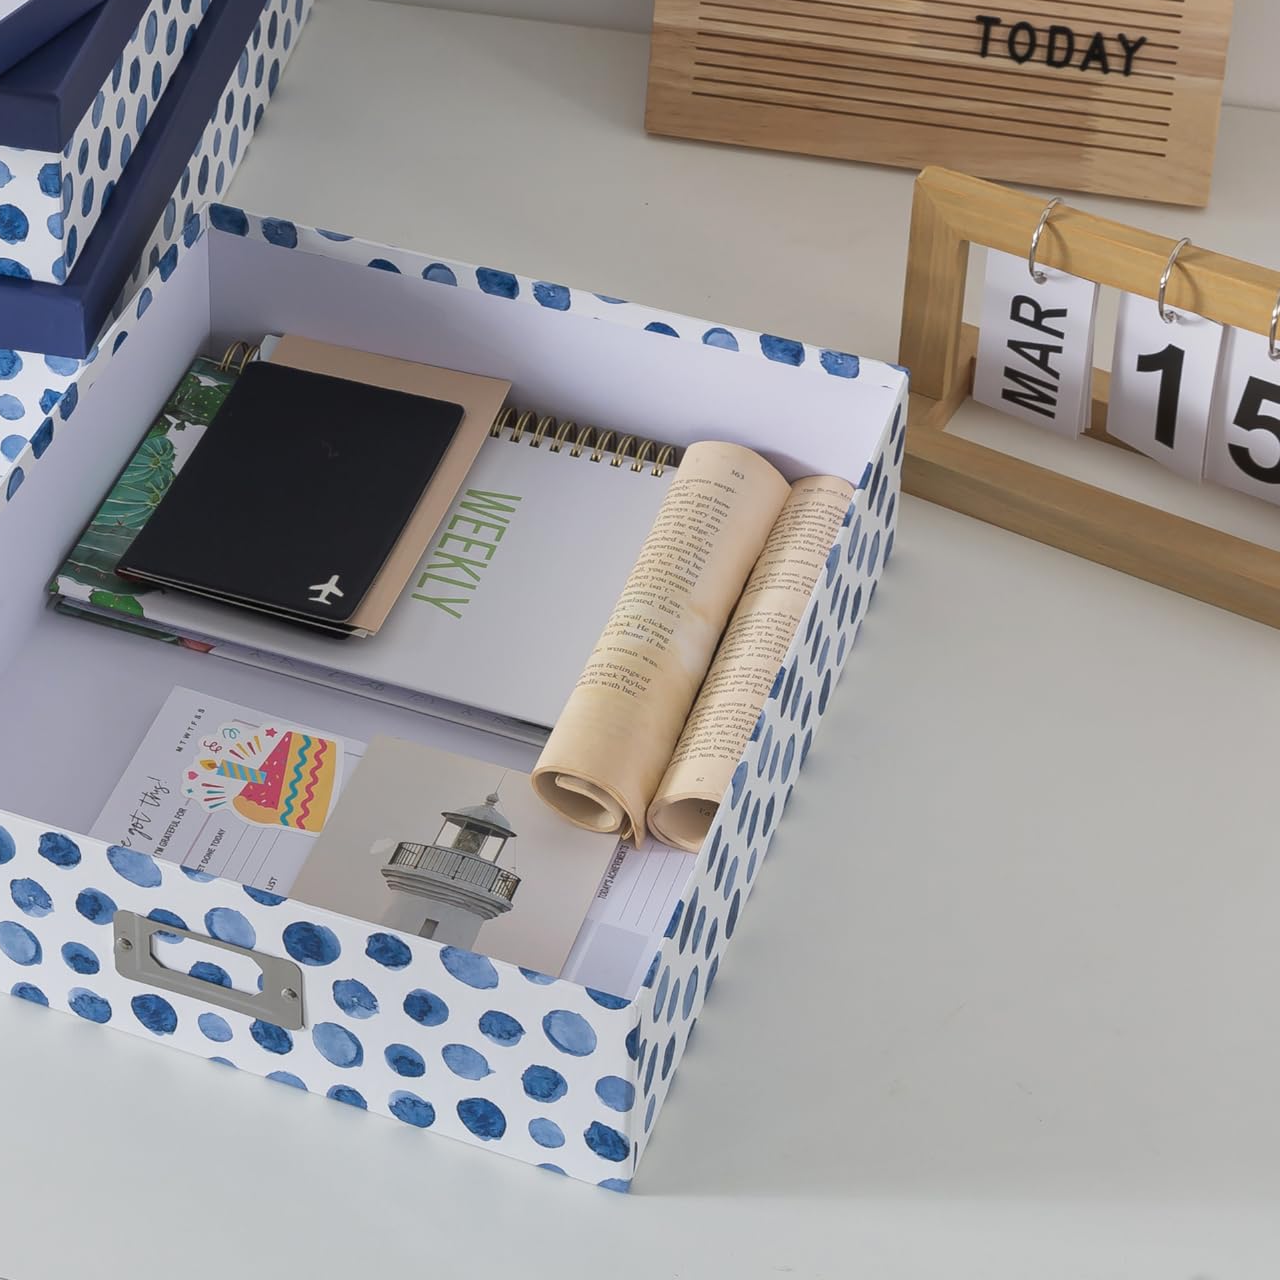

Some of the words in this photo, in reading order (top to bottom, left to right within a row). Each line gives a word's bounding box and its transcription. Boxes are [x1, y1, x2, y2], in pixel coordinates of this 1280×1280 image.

[975, 15, 1146, 75] TODAY
[1001, 294, 1068, 419] MAR
[1137, 344, 1185, 449] 1
[1227, 376, 1280, 484] 5
[412, 488, 522, 619] WEEKLY
[686, 541, 710, 554] major
[616, 630, 644, 640] phone
[655, 642, 666, 651] he
[637, 623, 649, 632] He
[651, 630, 670, 644] rang
[643, 618, 674, 635] clicked
[601, 681, 620, 690] with
[606, 662, 639, 678] feelings
[641, 675, 652, 684] of
[620, 674, 647, 692] Taylor
[139, 776, 170, 807] this!
[129, 809, 152, 840] got
[159, 819, 181, 848] GRATEFUL
[175, 807, 187, 820] FOR
[201, 847, 216, 865] DONE
[211, 828, 226, 848] TODAY
[607, 844, 629, 881] ACHIEVEMENTS
